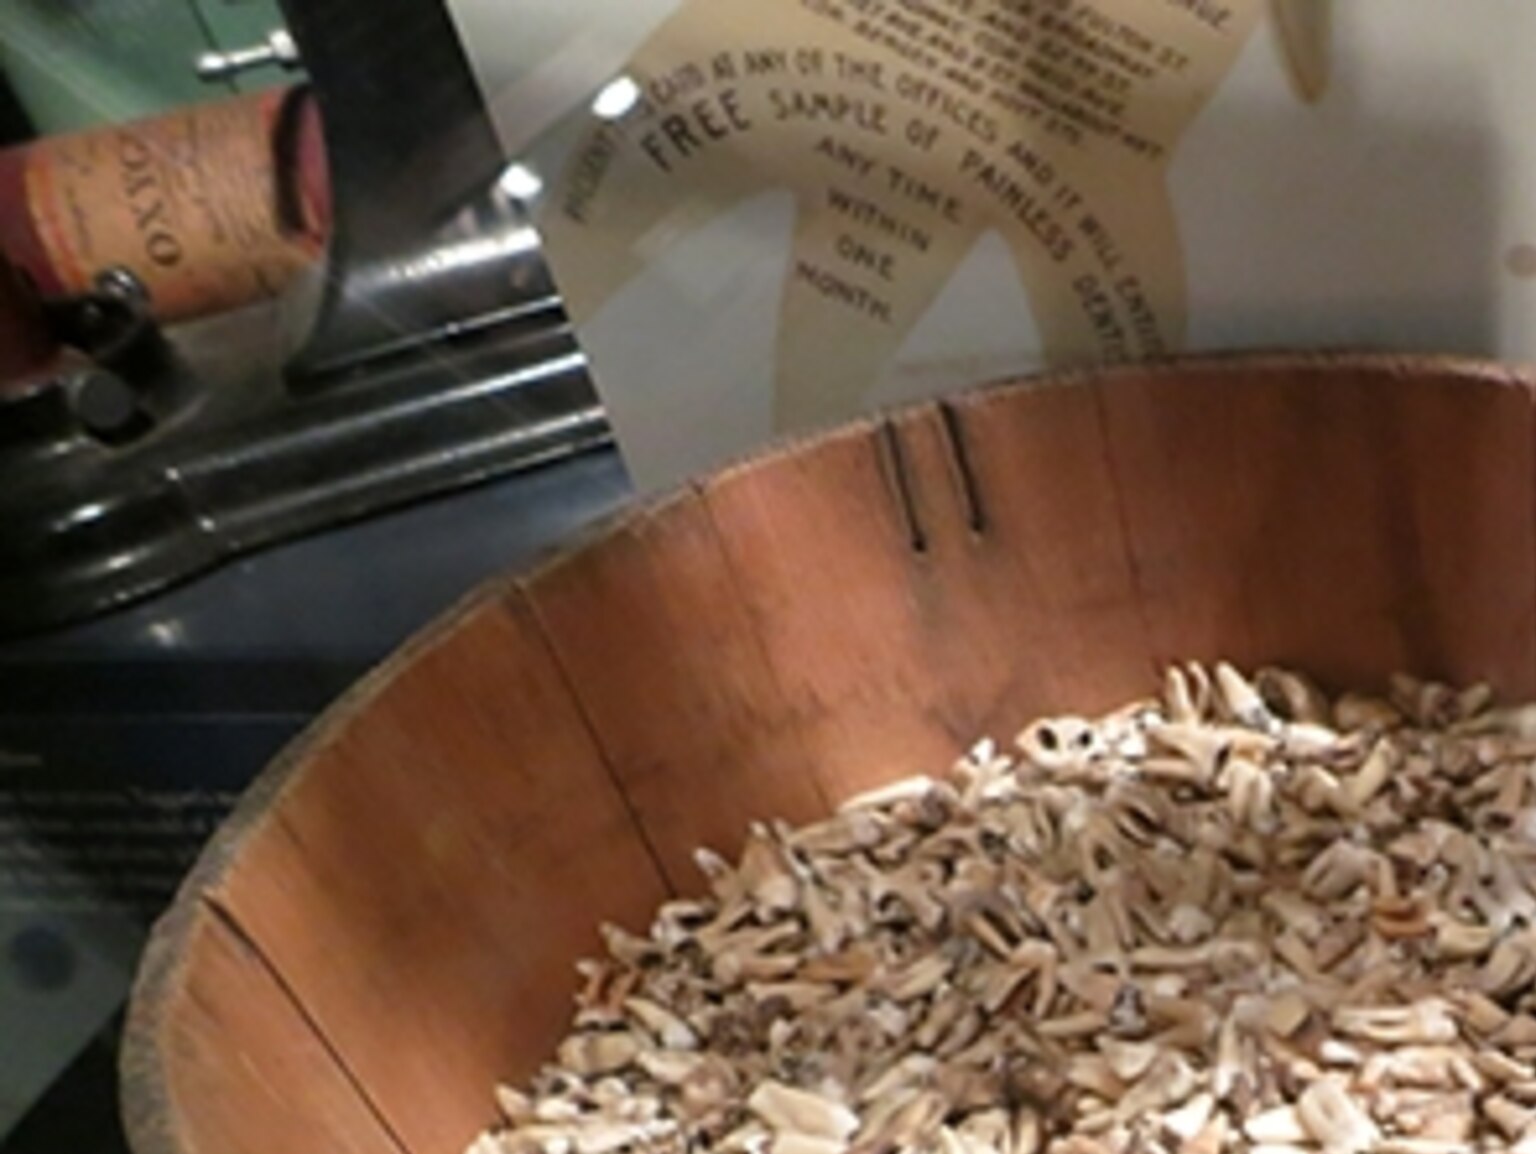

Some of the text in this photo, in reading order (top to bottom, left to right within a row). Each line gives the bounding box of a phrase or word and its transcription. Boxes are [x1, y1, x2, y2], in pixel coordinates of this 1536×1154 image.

[896, 72, 999, 144] OFFICES
[1006, 141, 1056, 184] AND
[640, 88, 752, 174] FREE
[768, 88, 889, 136] SAMPLE
[904, 118, 939, 151] OF
[959, 150, 1076, 262] PAINLESS
[814, 136, 964, 225] ANY TIME
[826, 186, 932, 254] WITHIN
[836, 233, 895, 282] ONE
